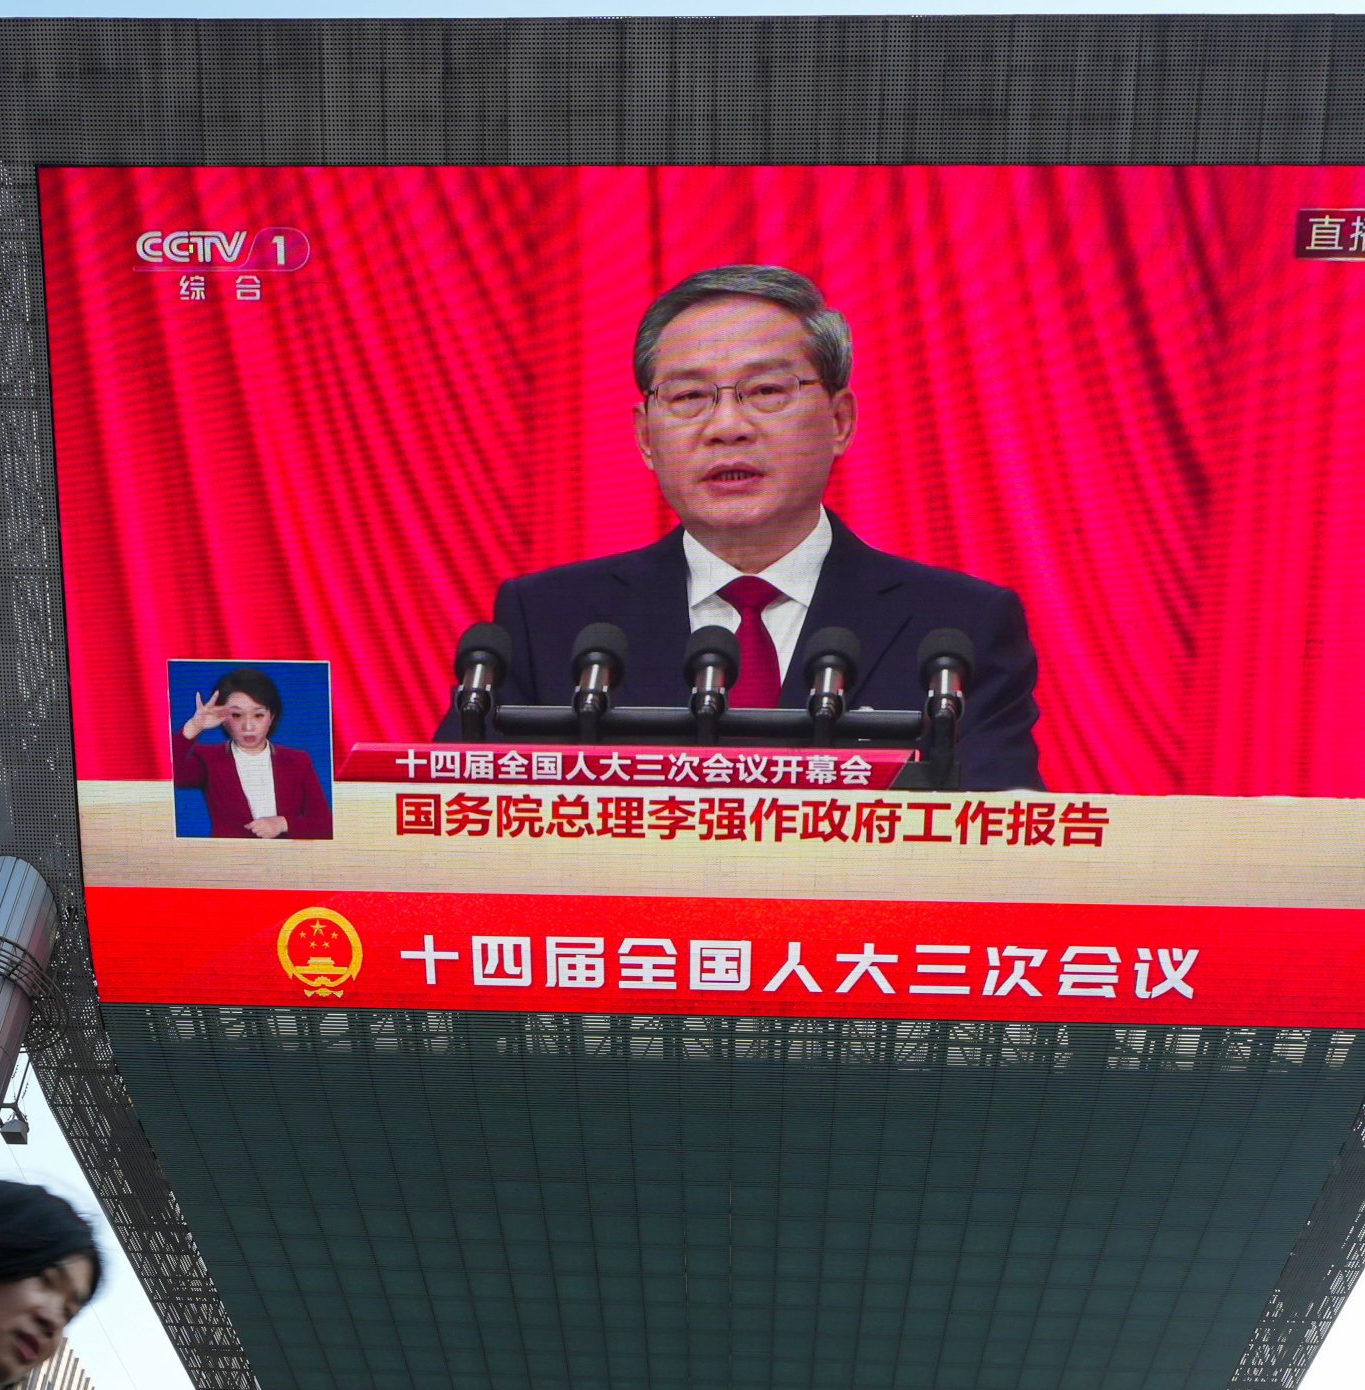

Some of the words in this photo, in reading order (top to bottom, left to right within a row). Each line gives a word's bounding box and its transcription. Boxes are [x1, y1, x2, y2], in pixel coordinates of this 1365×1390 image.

[135, 230, 248, 263] CCTV
[272, 235, 285, 266] 1
[179, 275, 261, 301] 综合
[395, 748, 873, 786] 十四届全国人大三次会议开幕会
[395, 791, 1110, 848] 国务院总理李强作政府工作报告
[400, 934, 1201, 1000] 十四届全国人大三次会议
